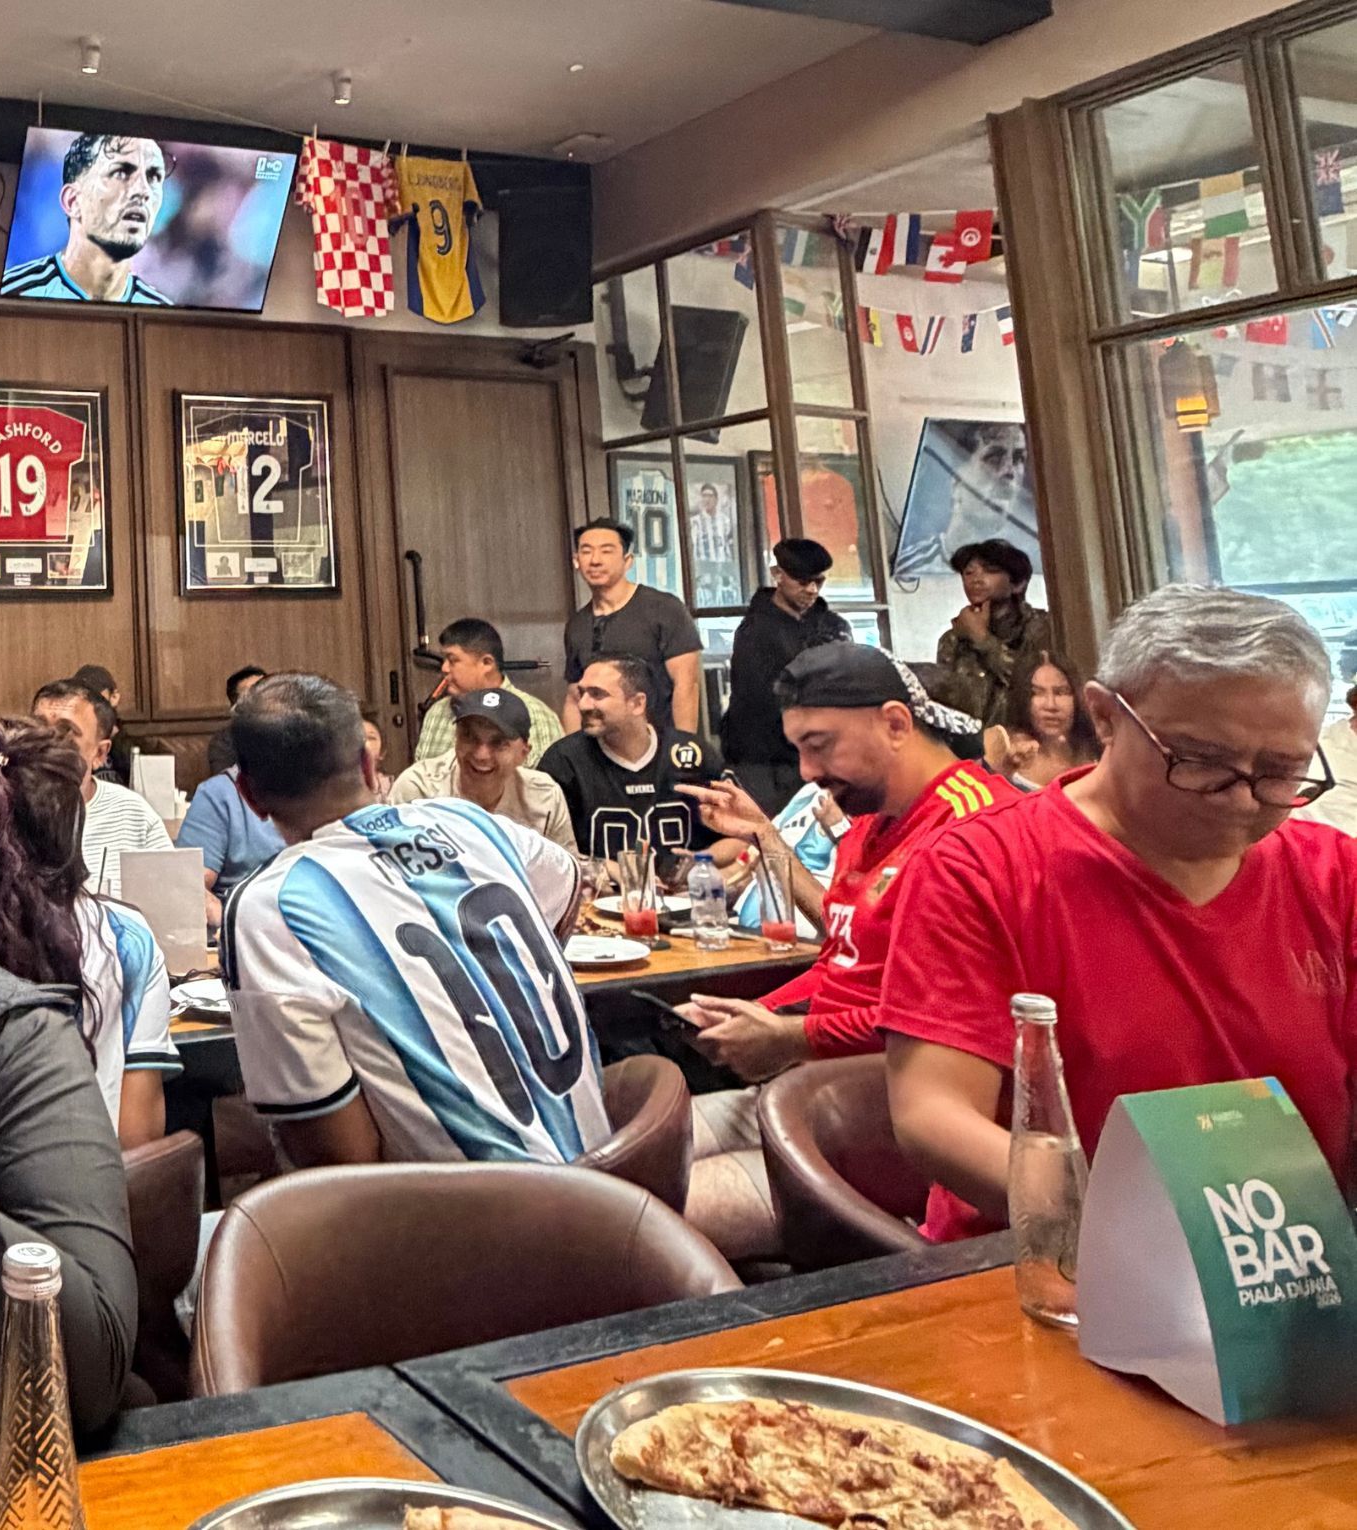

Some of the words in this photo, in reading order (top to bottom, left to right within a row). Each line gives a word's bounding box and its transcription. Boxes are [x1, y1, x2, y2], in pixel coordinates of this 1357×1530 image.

[429, 199, 453, 256] 9
[627, 505, 670, 557] 10
[368, 824, 465, 885] MESSI
[395, 882, 582, 1127] 10
[1203, 1179, 1285, 1237] NO
[1223, 1224, 1331, 1287] BAR
[1239, 1283, 1285, 1306] PIALA
[1286, 1275, 1338, 1298] DUNIA
